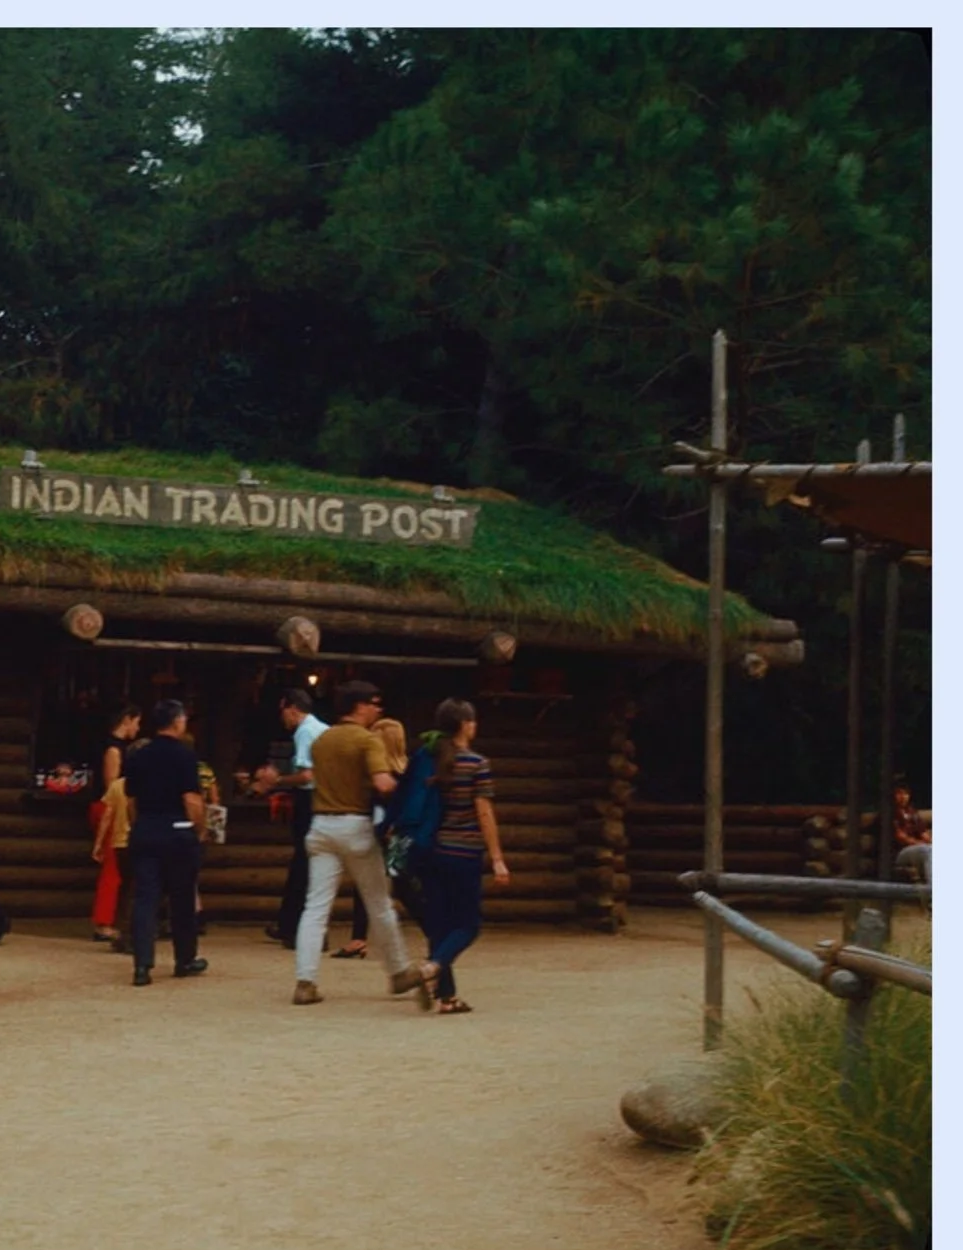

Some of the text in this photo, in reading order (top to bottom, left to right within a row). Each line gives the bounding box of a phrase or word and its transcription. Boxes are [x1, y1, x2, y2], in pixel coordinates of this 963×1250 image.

[10, 474, 468, 541] INDIAN TRADING POST
